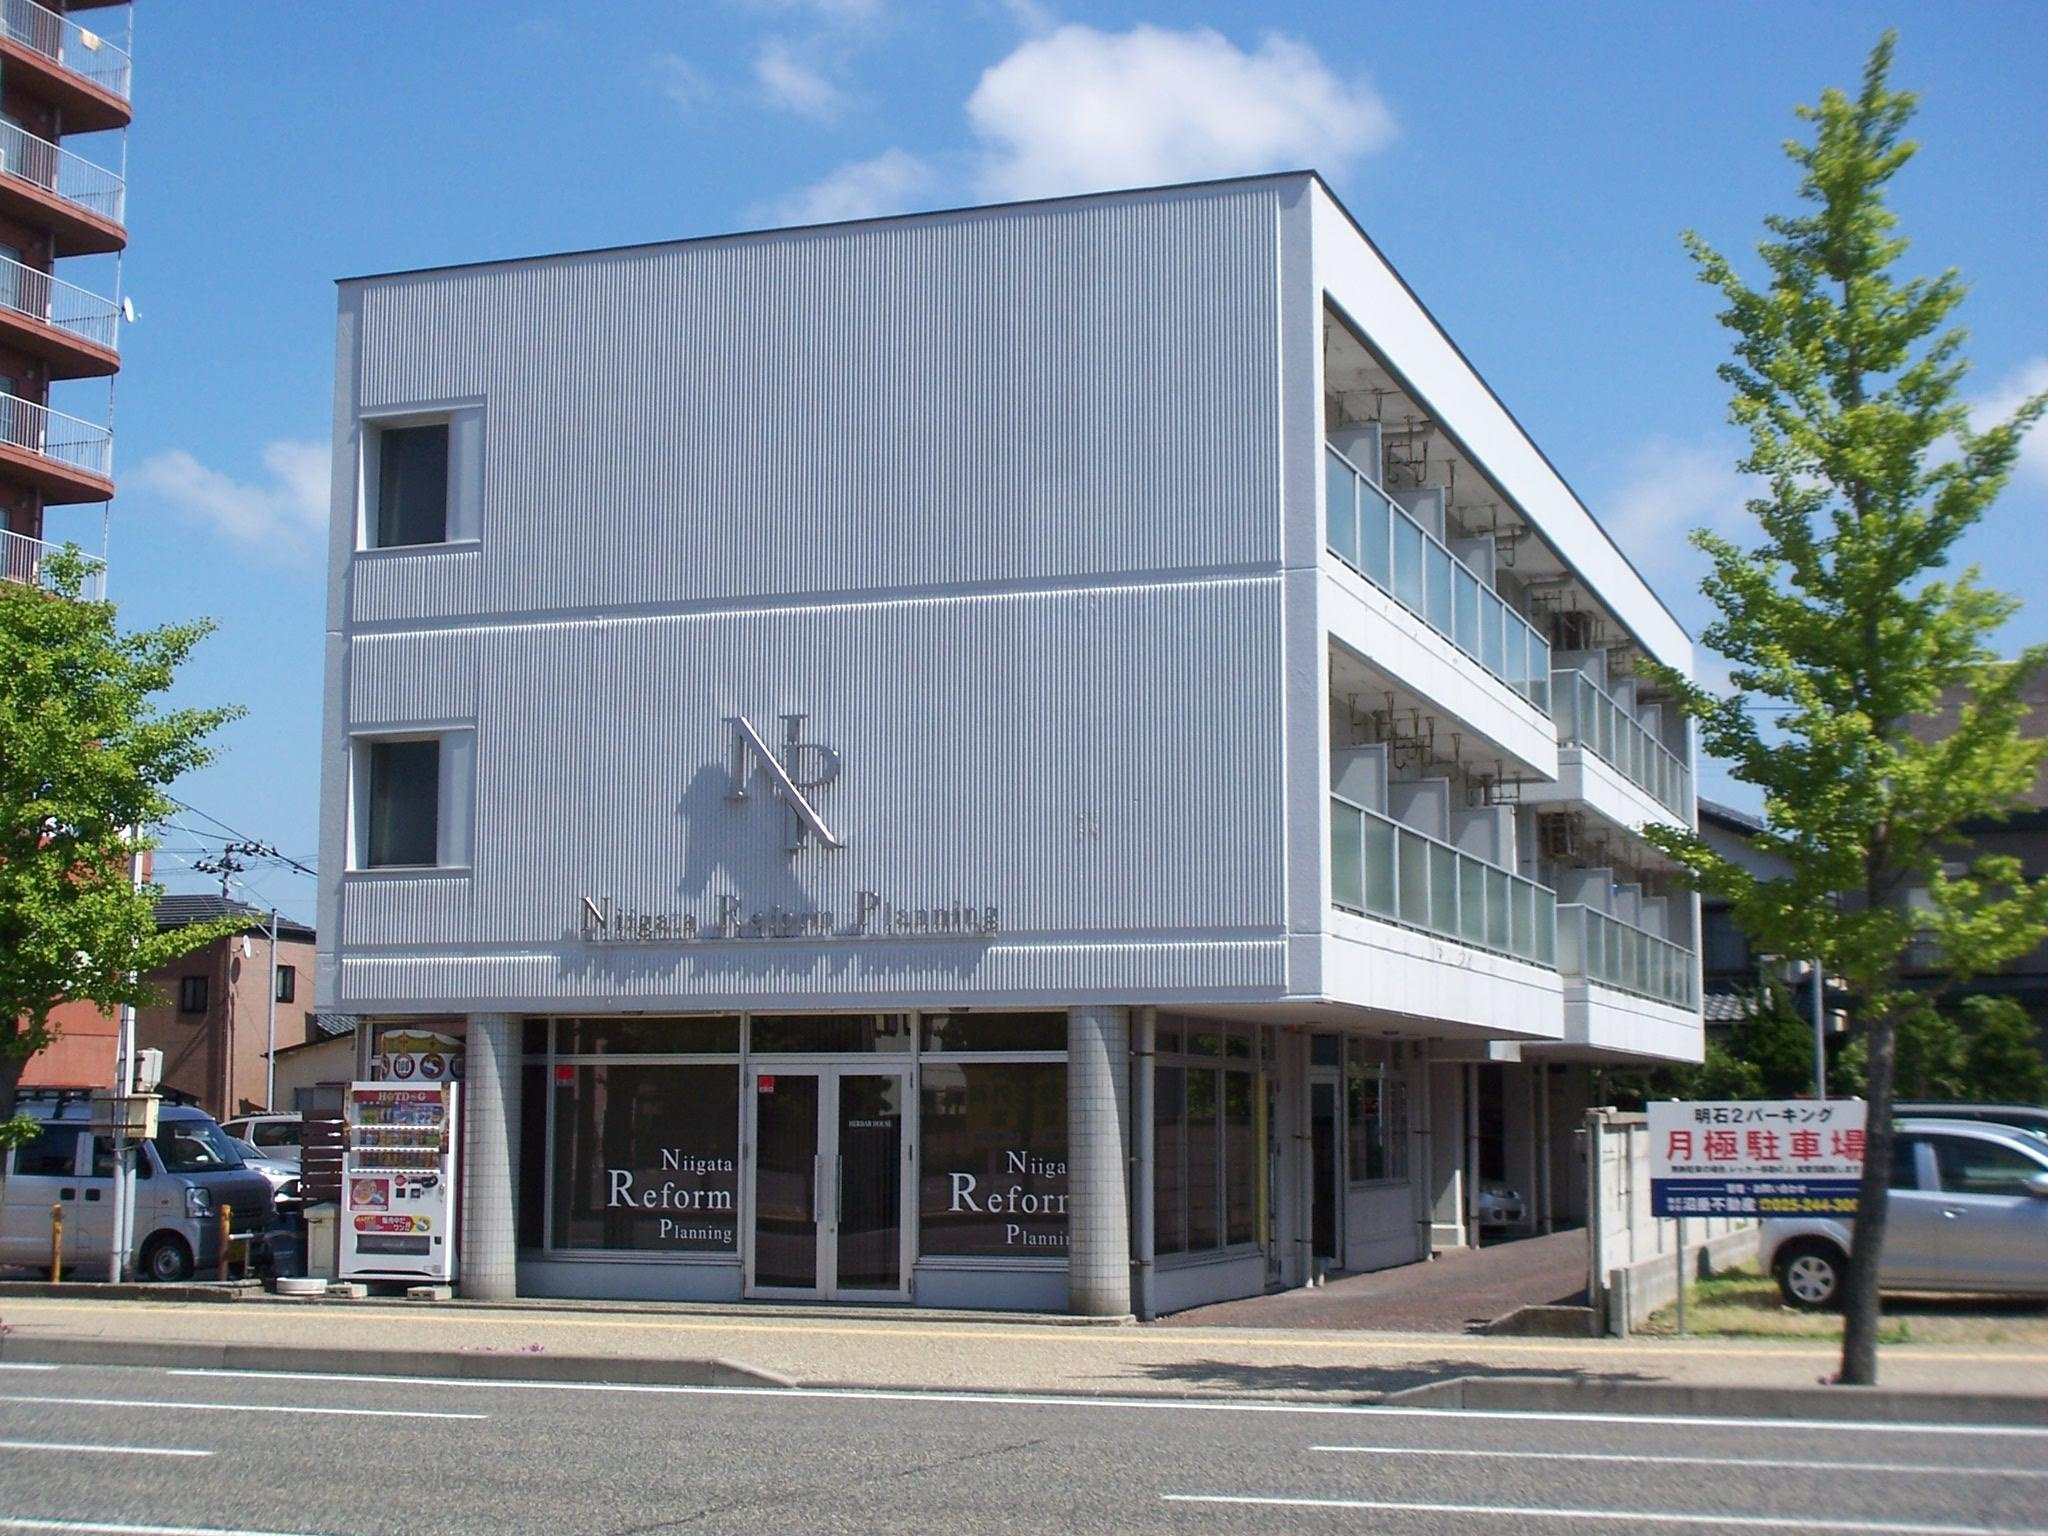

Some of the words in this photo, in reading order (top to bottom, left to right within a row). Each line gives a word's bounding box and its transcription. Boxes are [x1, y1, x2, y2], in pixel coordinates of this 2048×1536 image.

[581, 896, 698, 941] Niigata
[716, 894, 834, 938] Reform
[854, 890, 999, 936] Planning
[1694, 1107, 1834, 1125] 明石2パーキング
[1667, 1129, 1865, 1163] 月極駐車場
[661, 1148, 733, 1176] Niigata
[1005, 1150, 1068, 1179] Niiga
[607, 1169, 732, 1209] Reform
[659, 1218, 732, 1244] Planning
